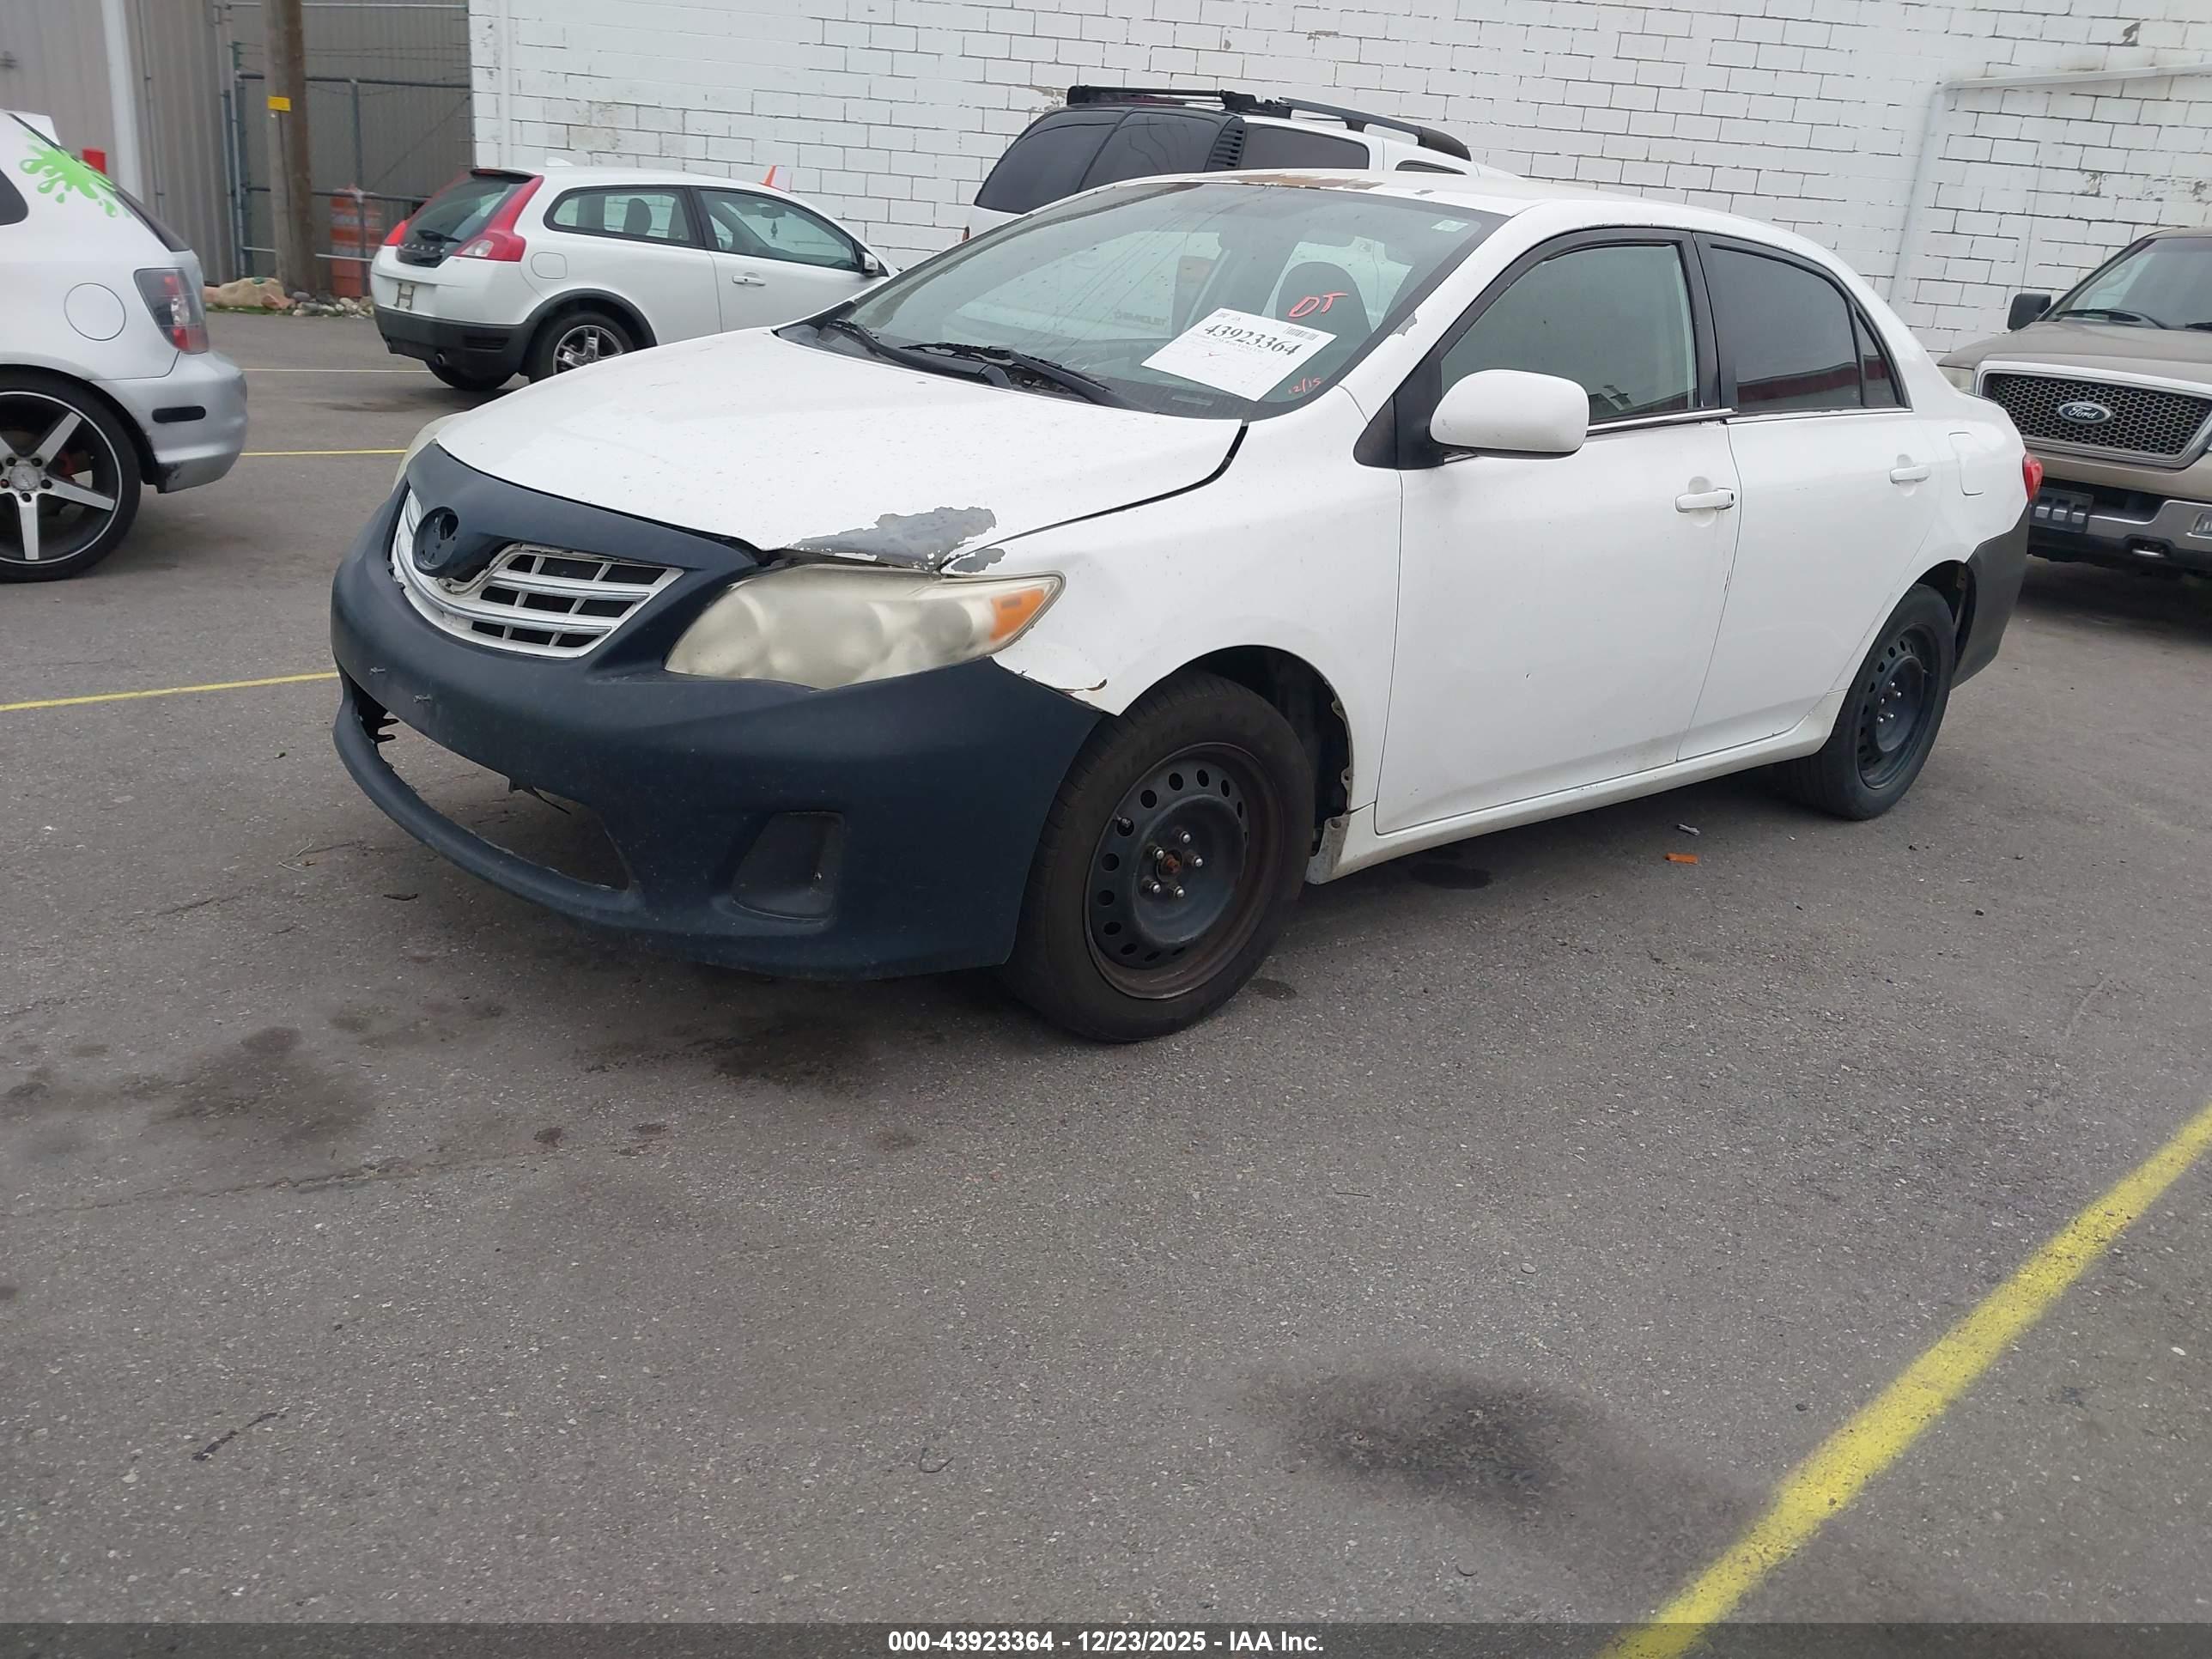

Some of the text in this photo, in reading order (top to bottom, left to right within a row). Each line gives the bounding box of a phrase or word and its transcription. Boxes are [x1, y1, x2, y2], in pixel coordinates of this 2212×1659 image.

[1288, 292, 1348, 318] DT
[1204, 324, 1304, 356] 43923364
[2068, 405, 2099, 419] Ford
